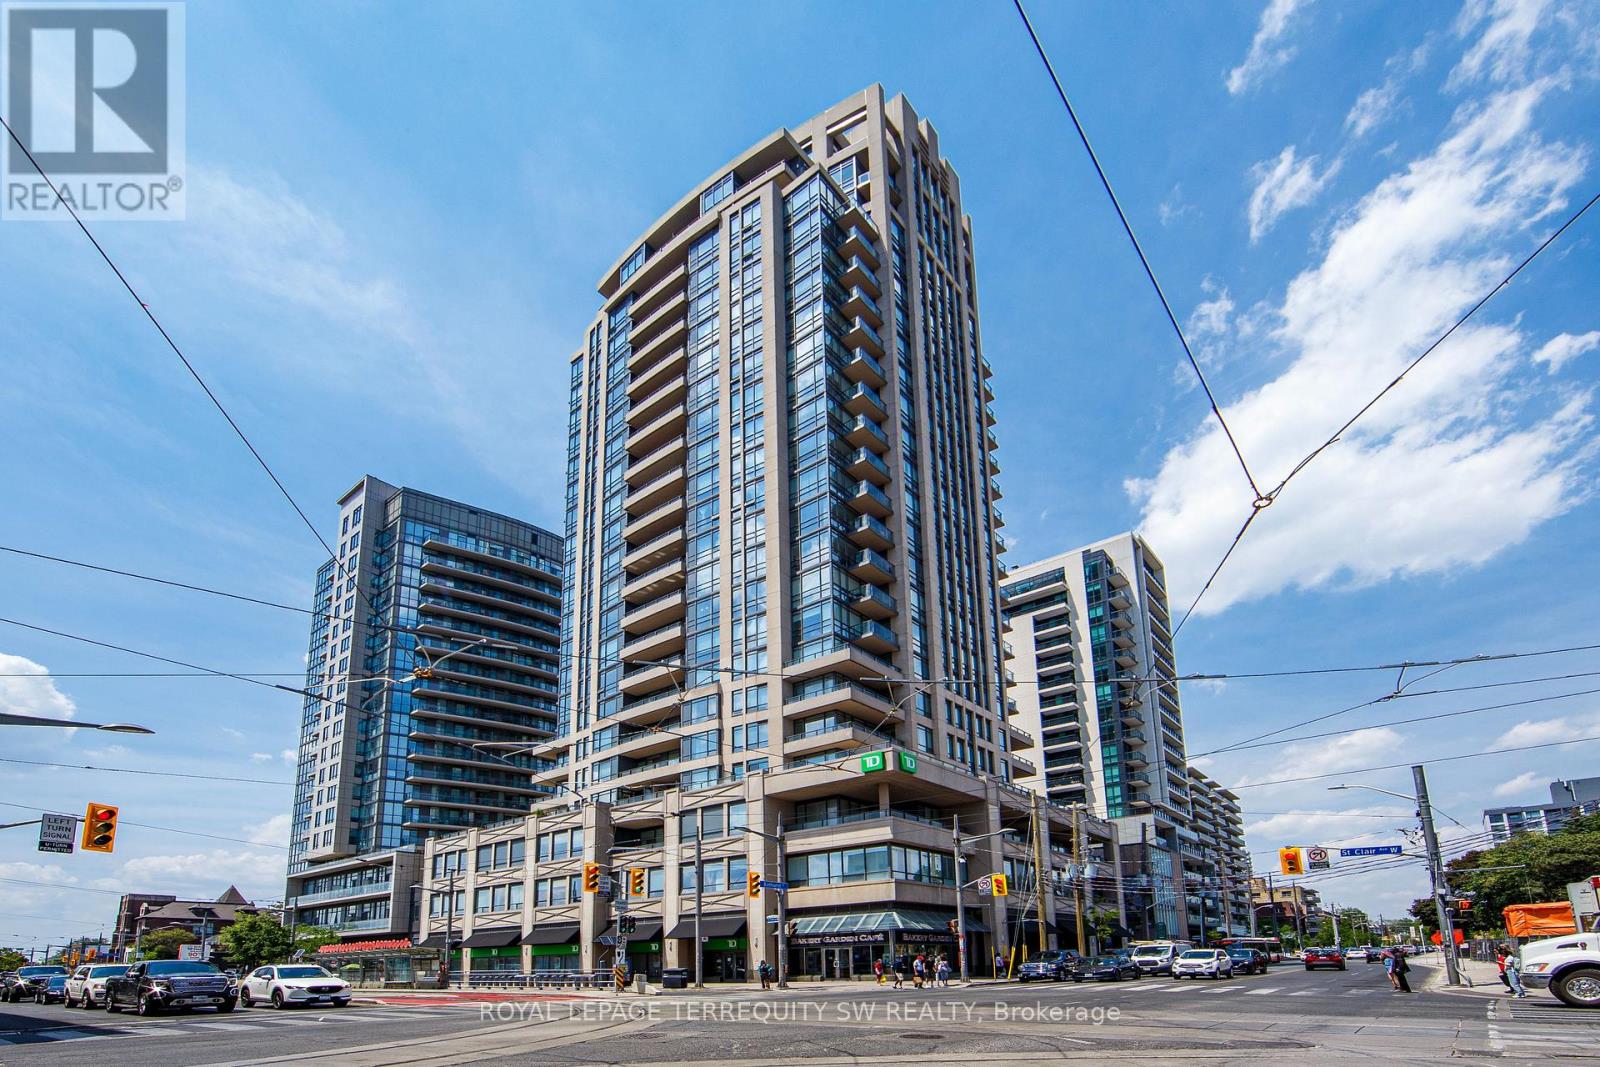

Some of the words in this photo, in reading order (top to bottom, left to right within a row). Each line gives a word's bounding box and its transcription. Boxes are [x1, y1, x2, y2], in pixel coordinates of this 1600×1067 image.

[863, 756, 880, 768] TD
[904, 756, 915, 768] TD
[43, 832, 70, 840] SIGNAL
[1354, 848, 1376, 856] Clair
[823, 935, 858, 943] GARDEN
[651, 943, 659, 951] TD
[728, 940, 737, 948] TD
